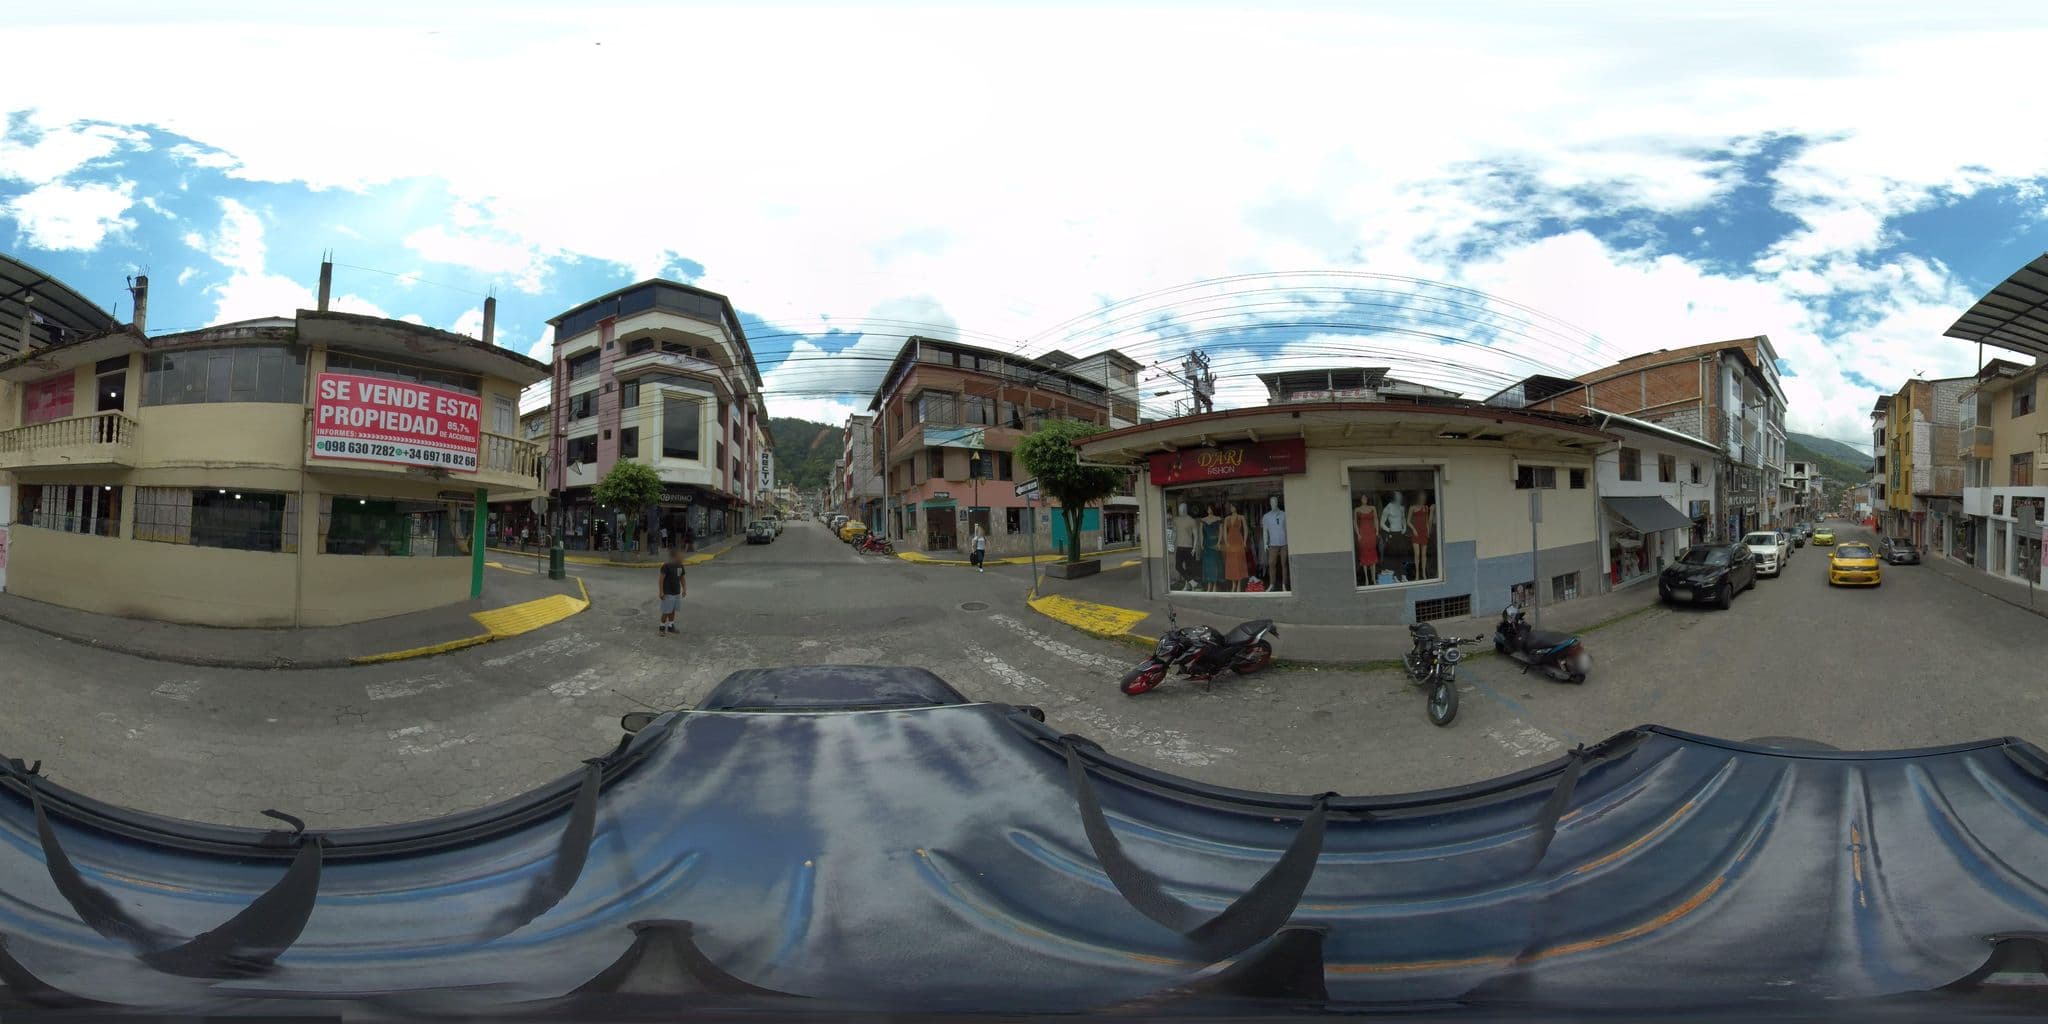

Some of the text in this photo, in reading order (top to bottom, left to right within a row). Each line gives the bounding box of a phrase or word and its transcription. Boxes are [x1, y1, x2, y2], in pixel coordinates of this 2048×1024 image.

[321, 379, 478, 421] SE VENDE ESTA
[319, 405, 438, 436] PROPIEDAD
[439, 430, 476, 443] DE ACCIONES
[324, 440, 395, 457] 098 630 7282
[423, 449, 440, 462] 697
[441, 452, 452, 464] 18
[453, 454, 464, 465] 82
[465, 456, 476, 467] 68
